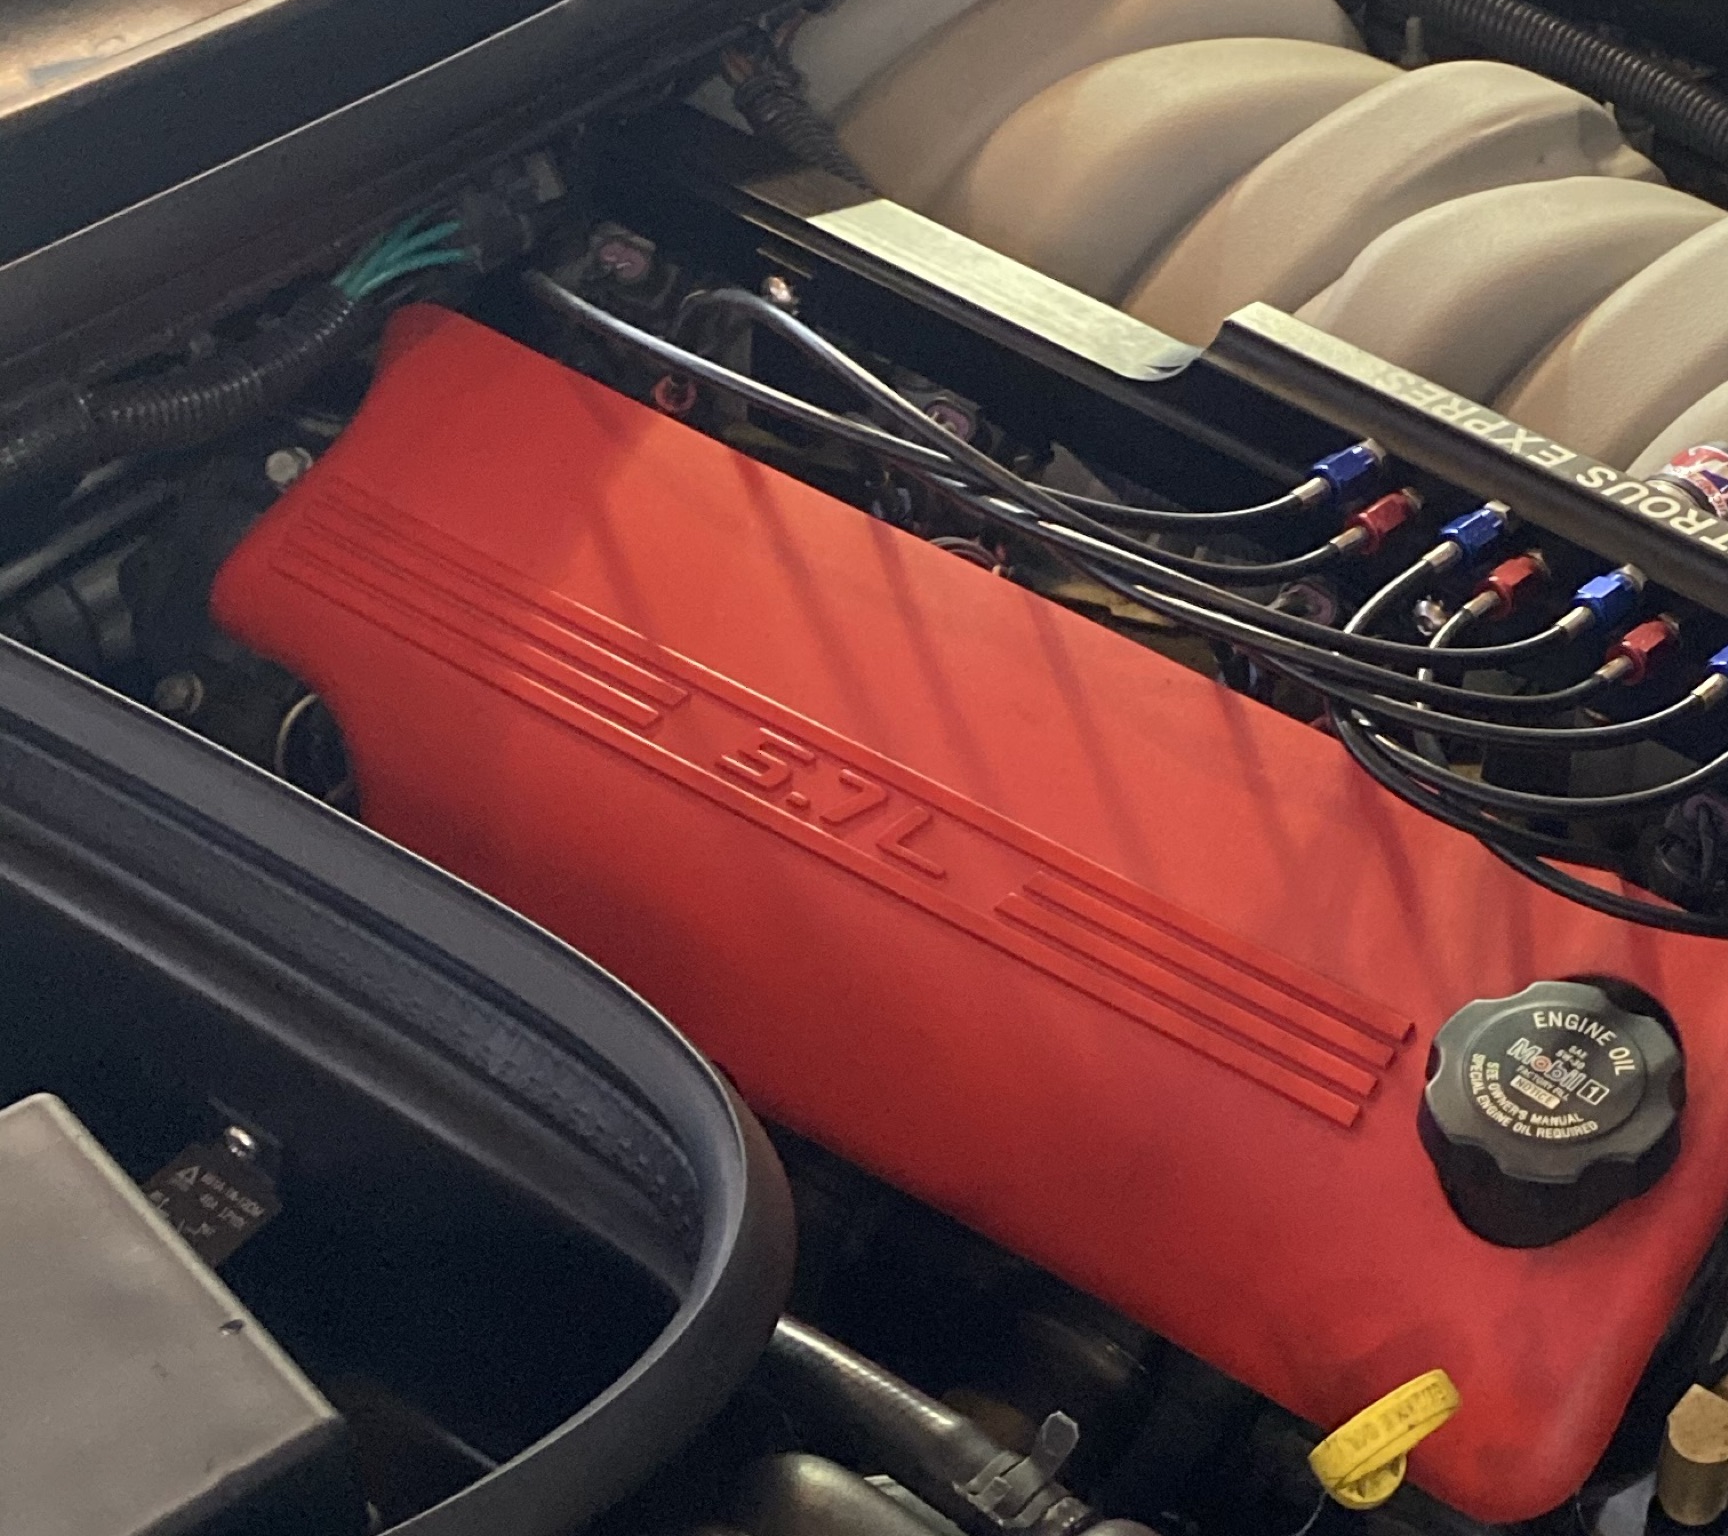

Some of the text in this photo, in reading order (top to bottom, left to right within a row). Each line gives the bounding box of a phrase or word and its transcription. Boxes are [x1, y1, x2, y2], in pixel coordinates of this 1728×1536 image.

[1372, 365, 1578, 470] EXPRES
[714, 726, 948, 880] 5.7L
[1506, 1037, 1588, 1092] Mobil
[1533, 1011, 1636, 1077] ENGINE OIL
[1469, 1053, 1599, 1139] SPECIAL ENGINE OIL REQUIRED
[1485, 1061, 1500, 1082] SEE
[1529, 1113, 1585, 1127] MANUAL
[1516, 1076, 1555, 1105] NOTICE
